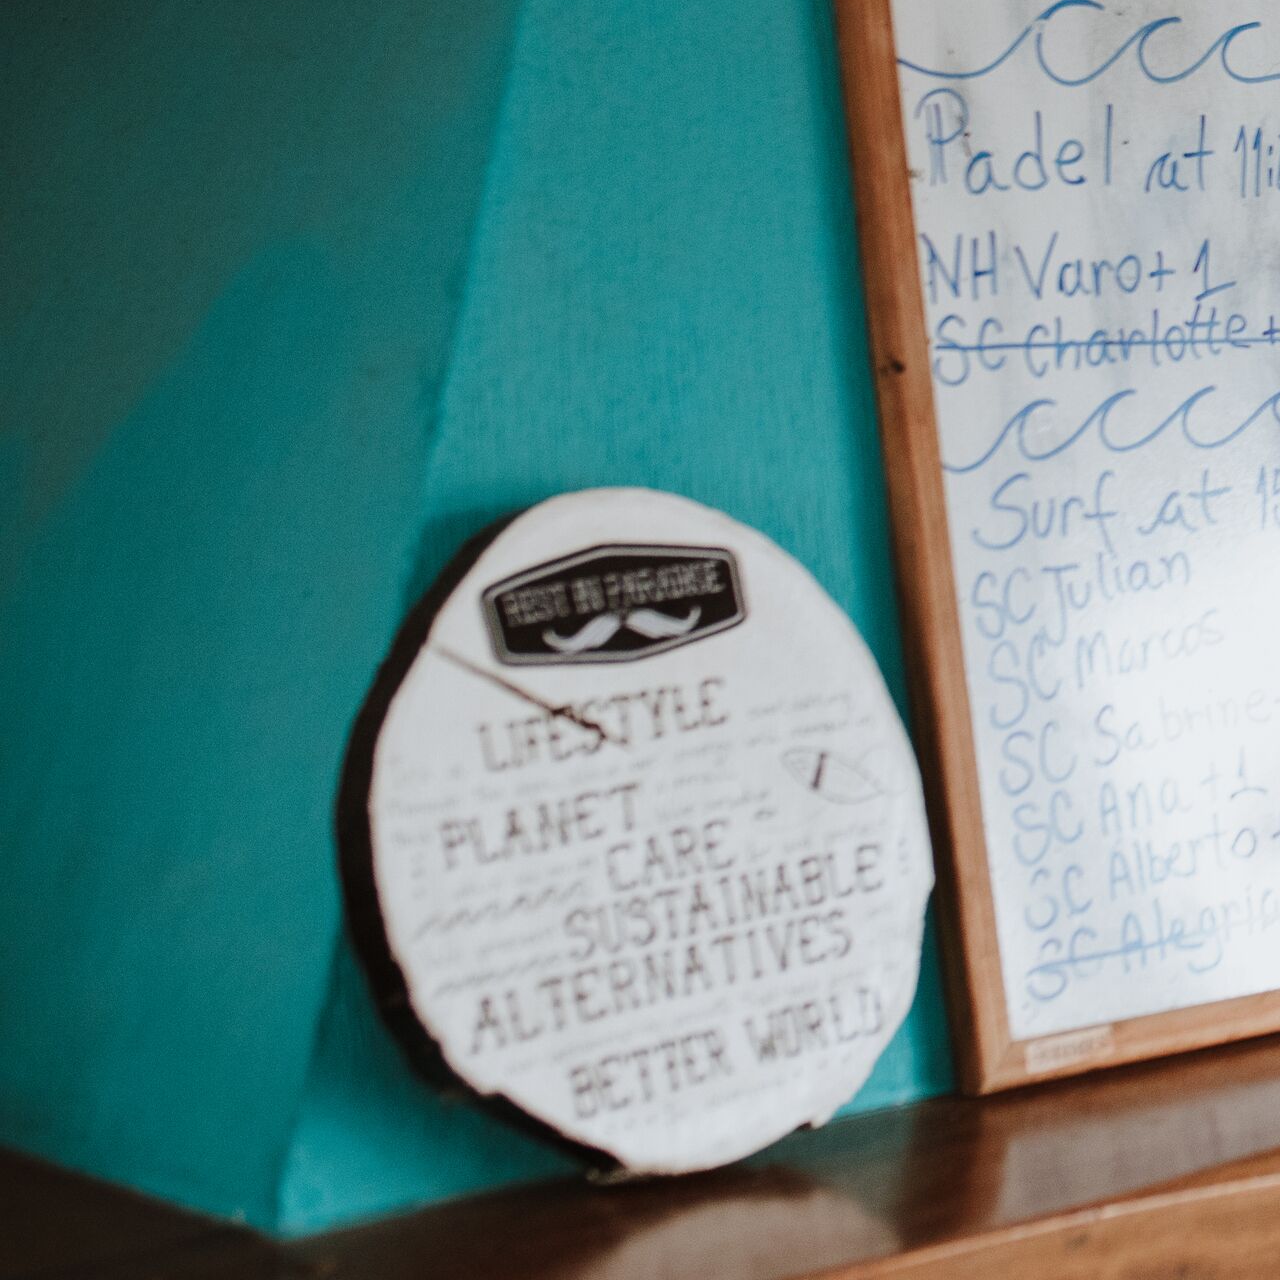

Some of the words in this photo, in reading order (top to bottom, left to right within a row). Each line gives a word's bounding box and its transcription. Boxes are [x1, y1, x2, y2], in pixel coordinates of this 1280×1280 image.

[915, 88, 1113, 195] Padel
[1145, 115, 1214, 193] at
[919, 230, 997, 304] NH
[972, 470, 1116, 554] Surf
[1139, 469, 1232, 535] at
[970, 567, 1033, 640] SC
[1041, 550, 1192, 647] Julian
[990, 634, 1061, 728] SC
[1077, 609, 1225, 690] Marcos
[477, 676, 730, 773] LIFESTYLE
[1000, 721, 1077, 796] SC
[439, 780, 643, 872] PLANET
[606, 818, 738, 895] CARE
[1011, 790, 1084, 865] SC
[563, 840, 886, 965] SUSTAINABLE
[470, 909, 855, 1056] ALTERNATIVES
[569, 1026, 735, 1120] BETTER
[748, 984, 884, 1061] WORLD
